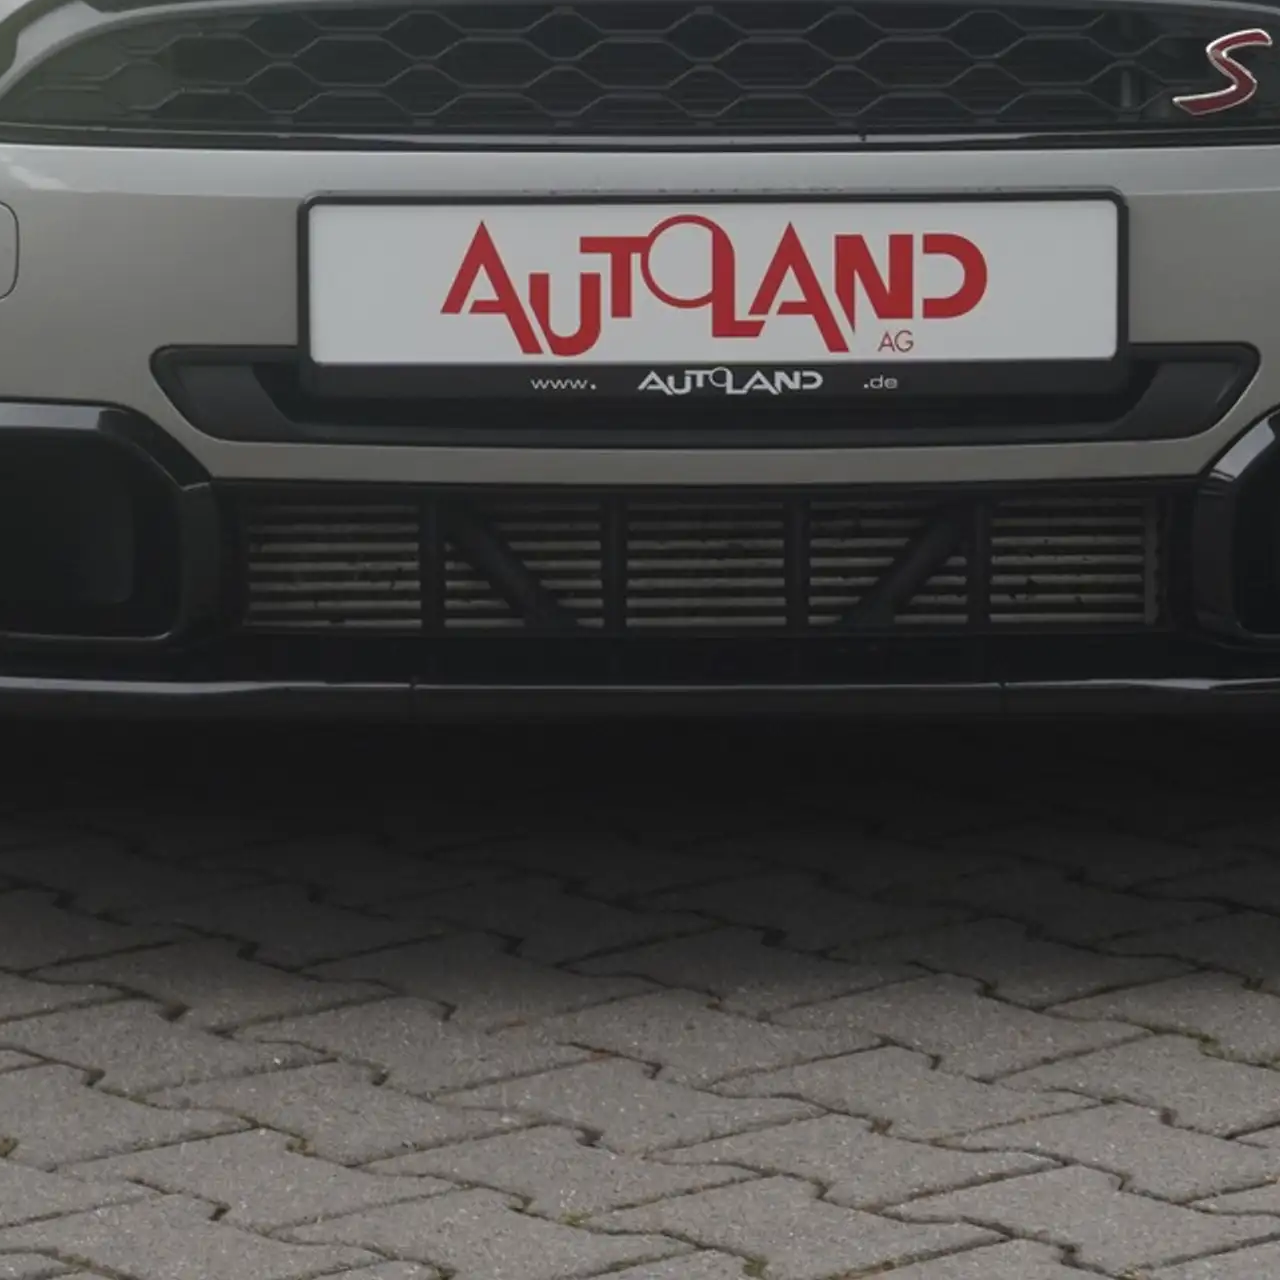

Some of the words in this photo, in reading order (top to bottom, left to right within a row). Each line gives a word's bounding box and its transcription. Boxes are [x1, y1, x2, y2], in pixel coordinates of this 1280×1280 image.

[1172, 28, 1272, 115] S
[441, 214, 988, 357] AUTOLAND
[877, 330, 914, 353] AG
[530, 377, 597, 391] www.
[637, 366, 824, 396] AUTOLAND
[863, 374, 898, 389] .de
